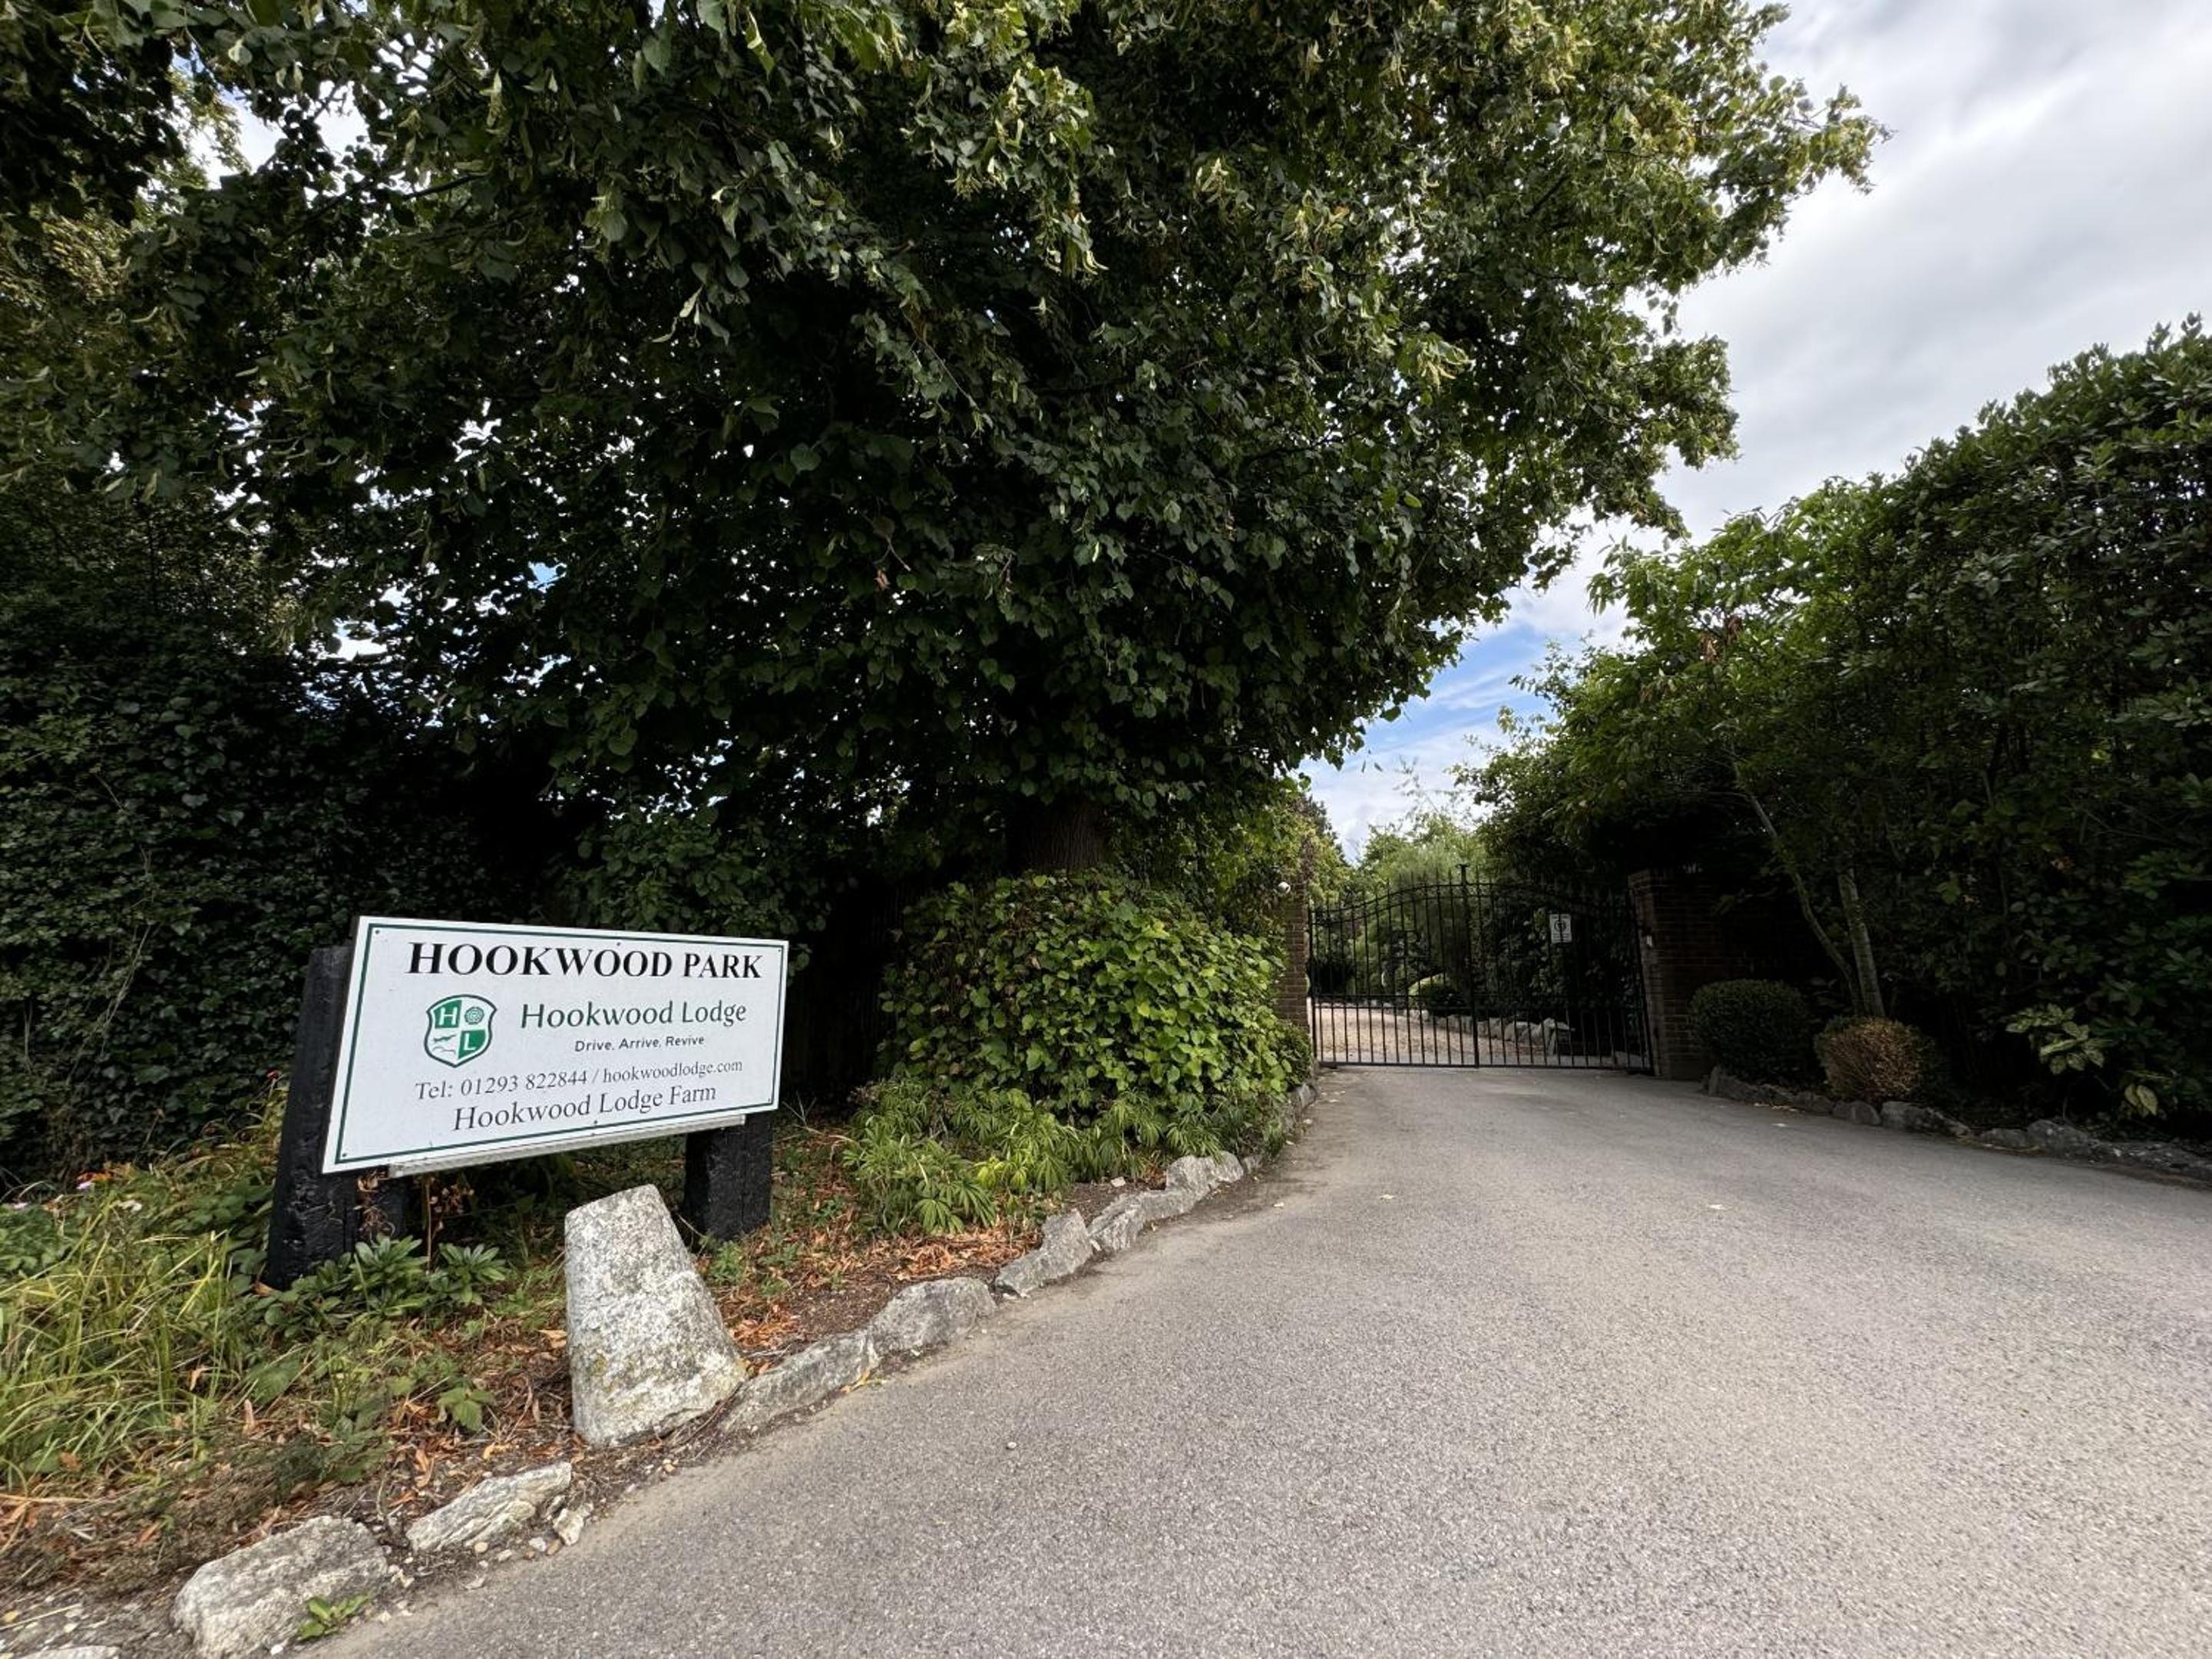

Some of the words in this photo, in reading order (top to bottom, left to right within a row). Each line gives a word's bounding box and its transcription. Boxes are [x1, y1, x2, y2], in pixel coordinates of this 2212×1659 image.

[405, 942, 673, 977] HOOKWOOD
[683, 953, 764, 979] PARK
[438, 1006, 458, 1026] H
[521, 1000, 673, 1029] Hookwood
[682, 1000, 746, 1027] Lodge
[464, 1033, 476, 1051] L
[666, 1035, 705, 1047] Revive
[415, 1080, 452, 1099] Tel:
[461, 1075, 518, 1096] 01293
[525, 1069, 587, 1091] 822844
[603, 1060, 742, 1083] hookwoodlodge.com
[452, 1093, 590, 1132] Hookwood
[600, 1089, 663, 1114] Lodge
[670, 1085, 716, 1105] Farm
